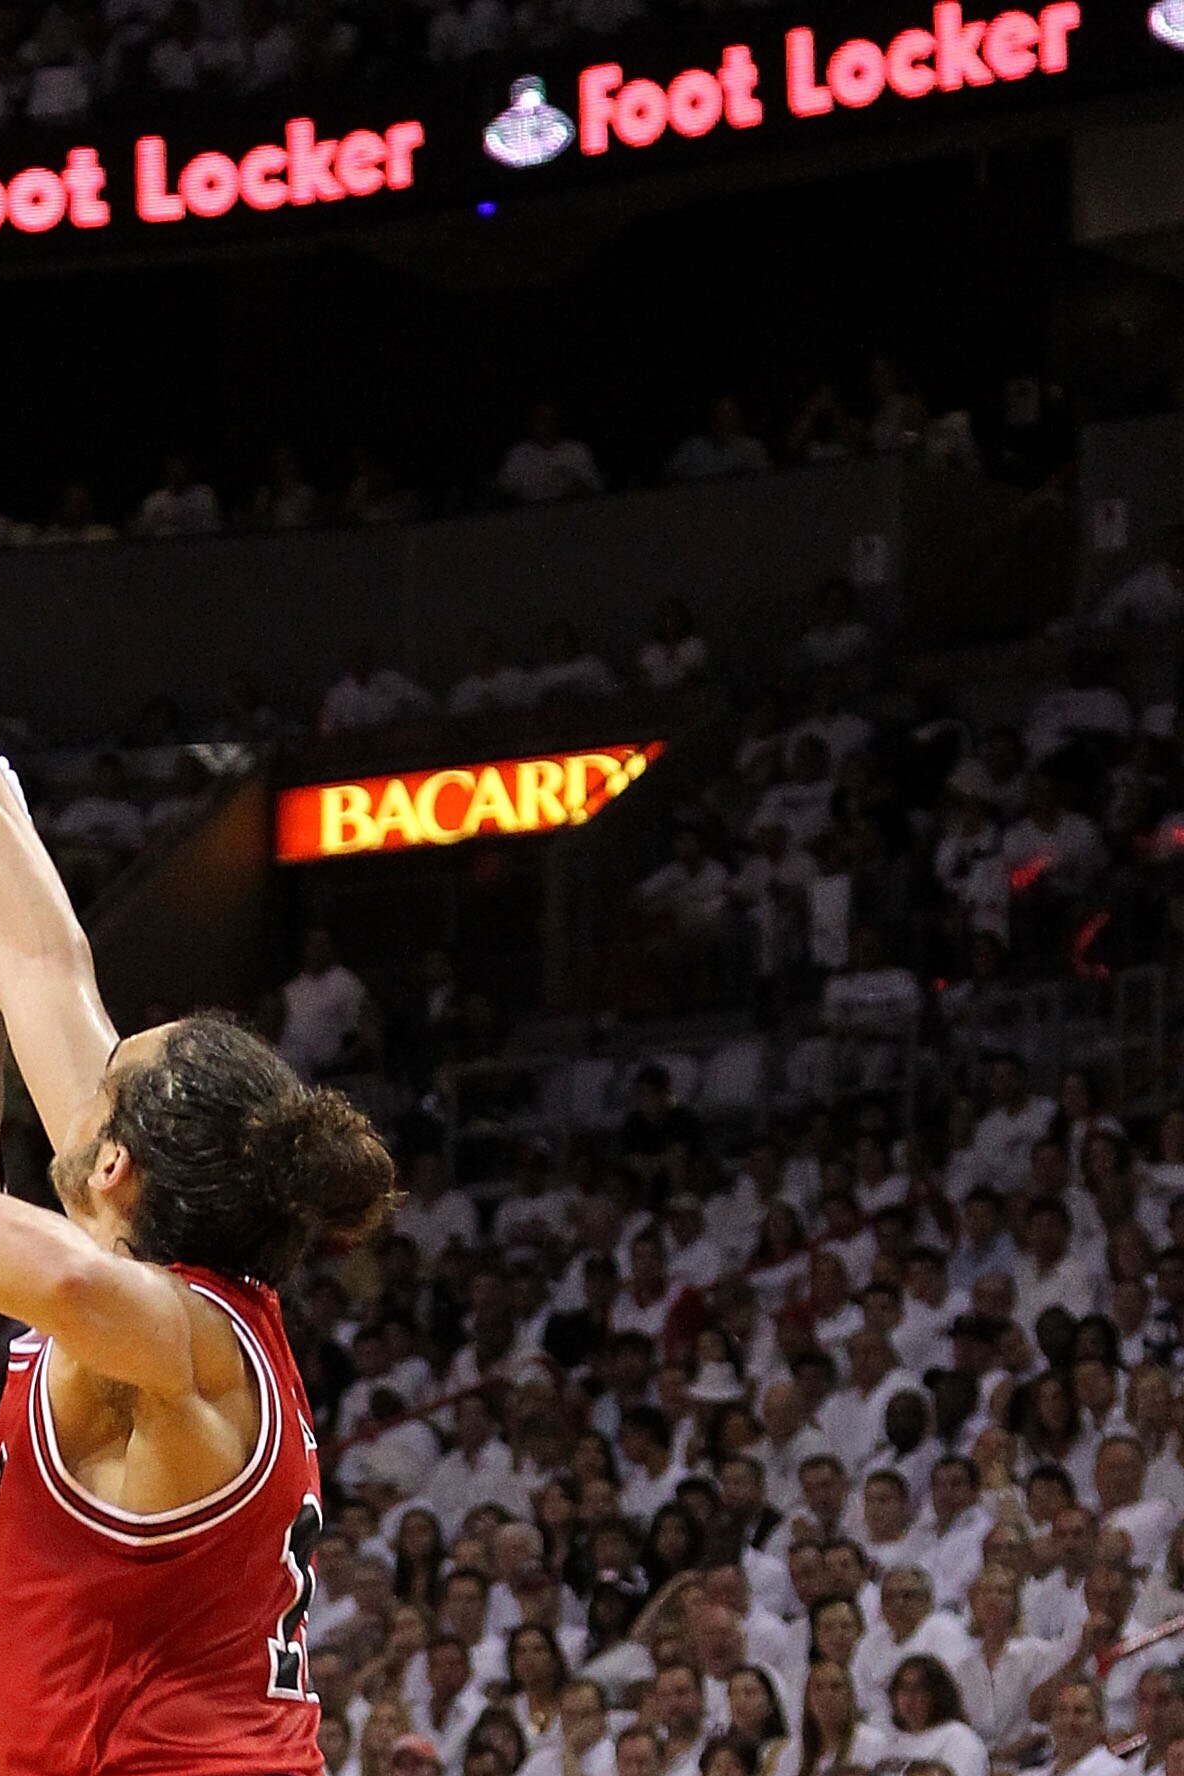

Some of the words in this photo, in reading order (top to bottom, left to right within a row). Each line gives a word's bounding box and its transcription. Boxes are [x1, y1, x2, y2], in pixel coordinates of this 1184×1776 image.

[579, 44, 763, 155] Foot
[785, 1, 1081, 118] Locker
[135, 117, 425, 223] Locker
